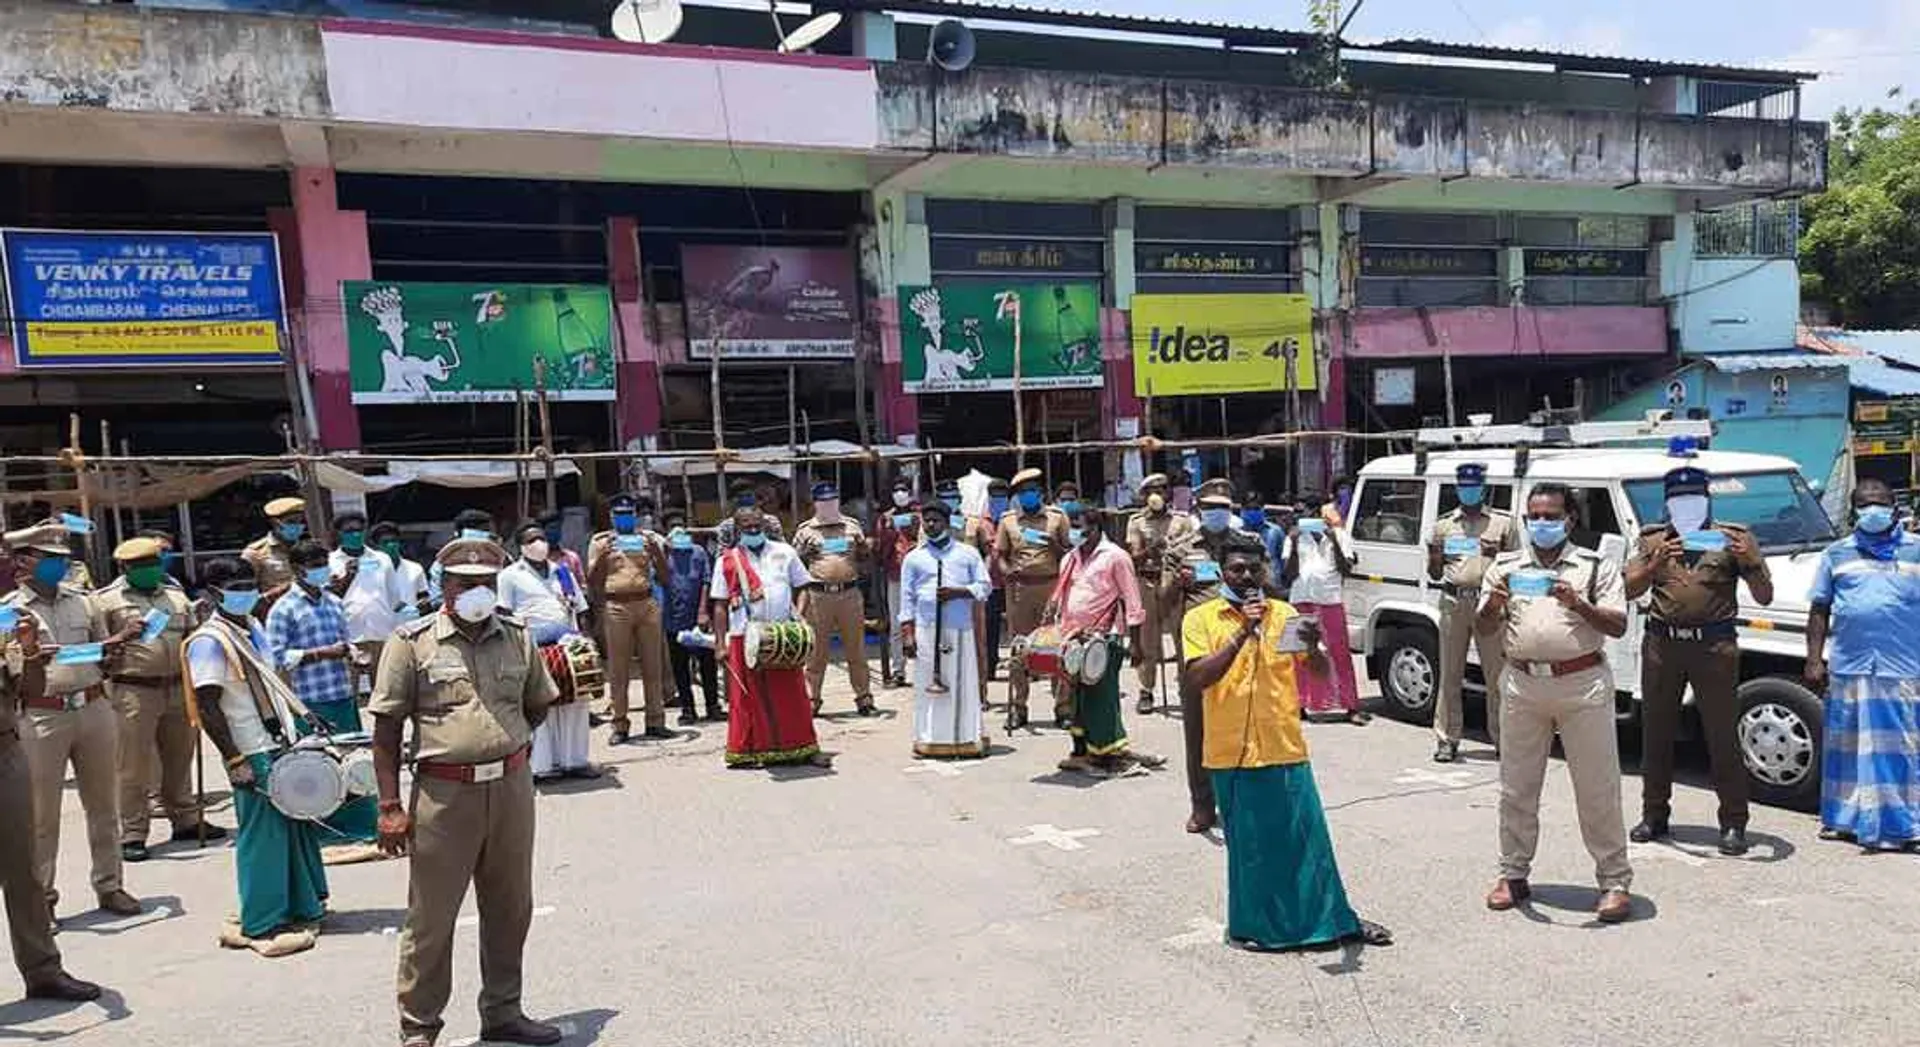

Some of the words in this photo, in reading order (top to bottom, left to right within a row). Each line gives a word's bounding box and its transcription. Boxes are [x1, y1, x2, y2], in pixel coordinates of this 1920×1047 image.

[35, 264, 130, 281] VENKY
[136, 265, 253, 281] TRAVELS
[41, 303, 146, 318] CHIDAMBARAM
[160, 303, 219, 317] CHENNAI
